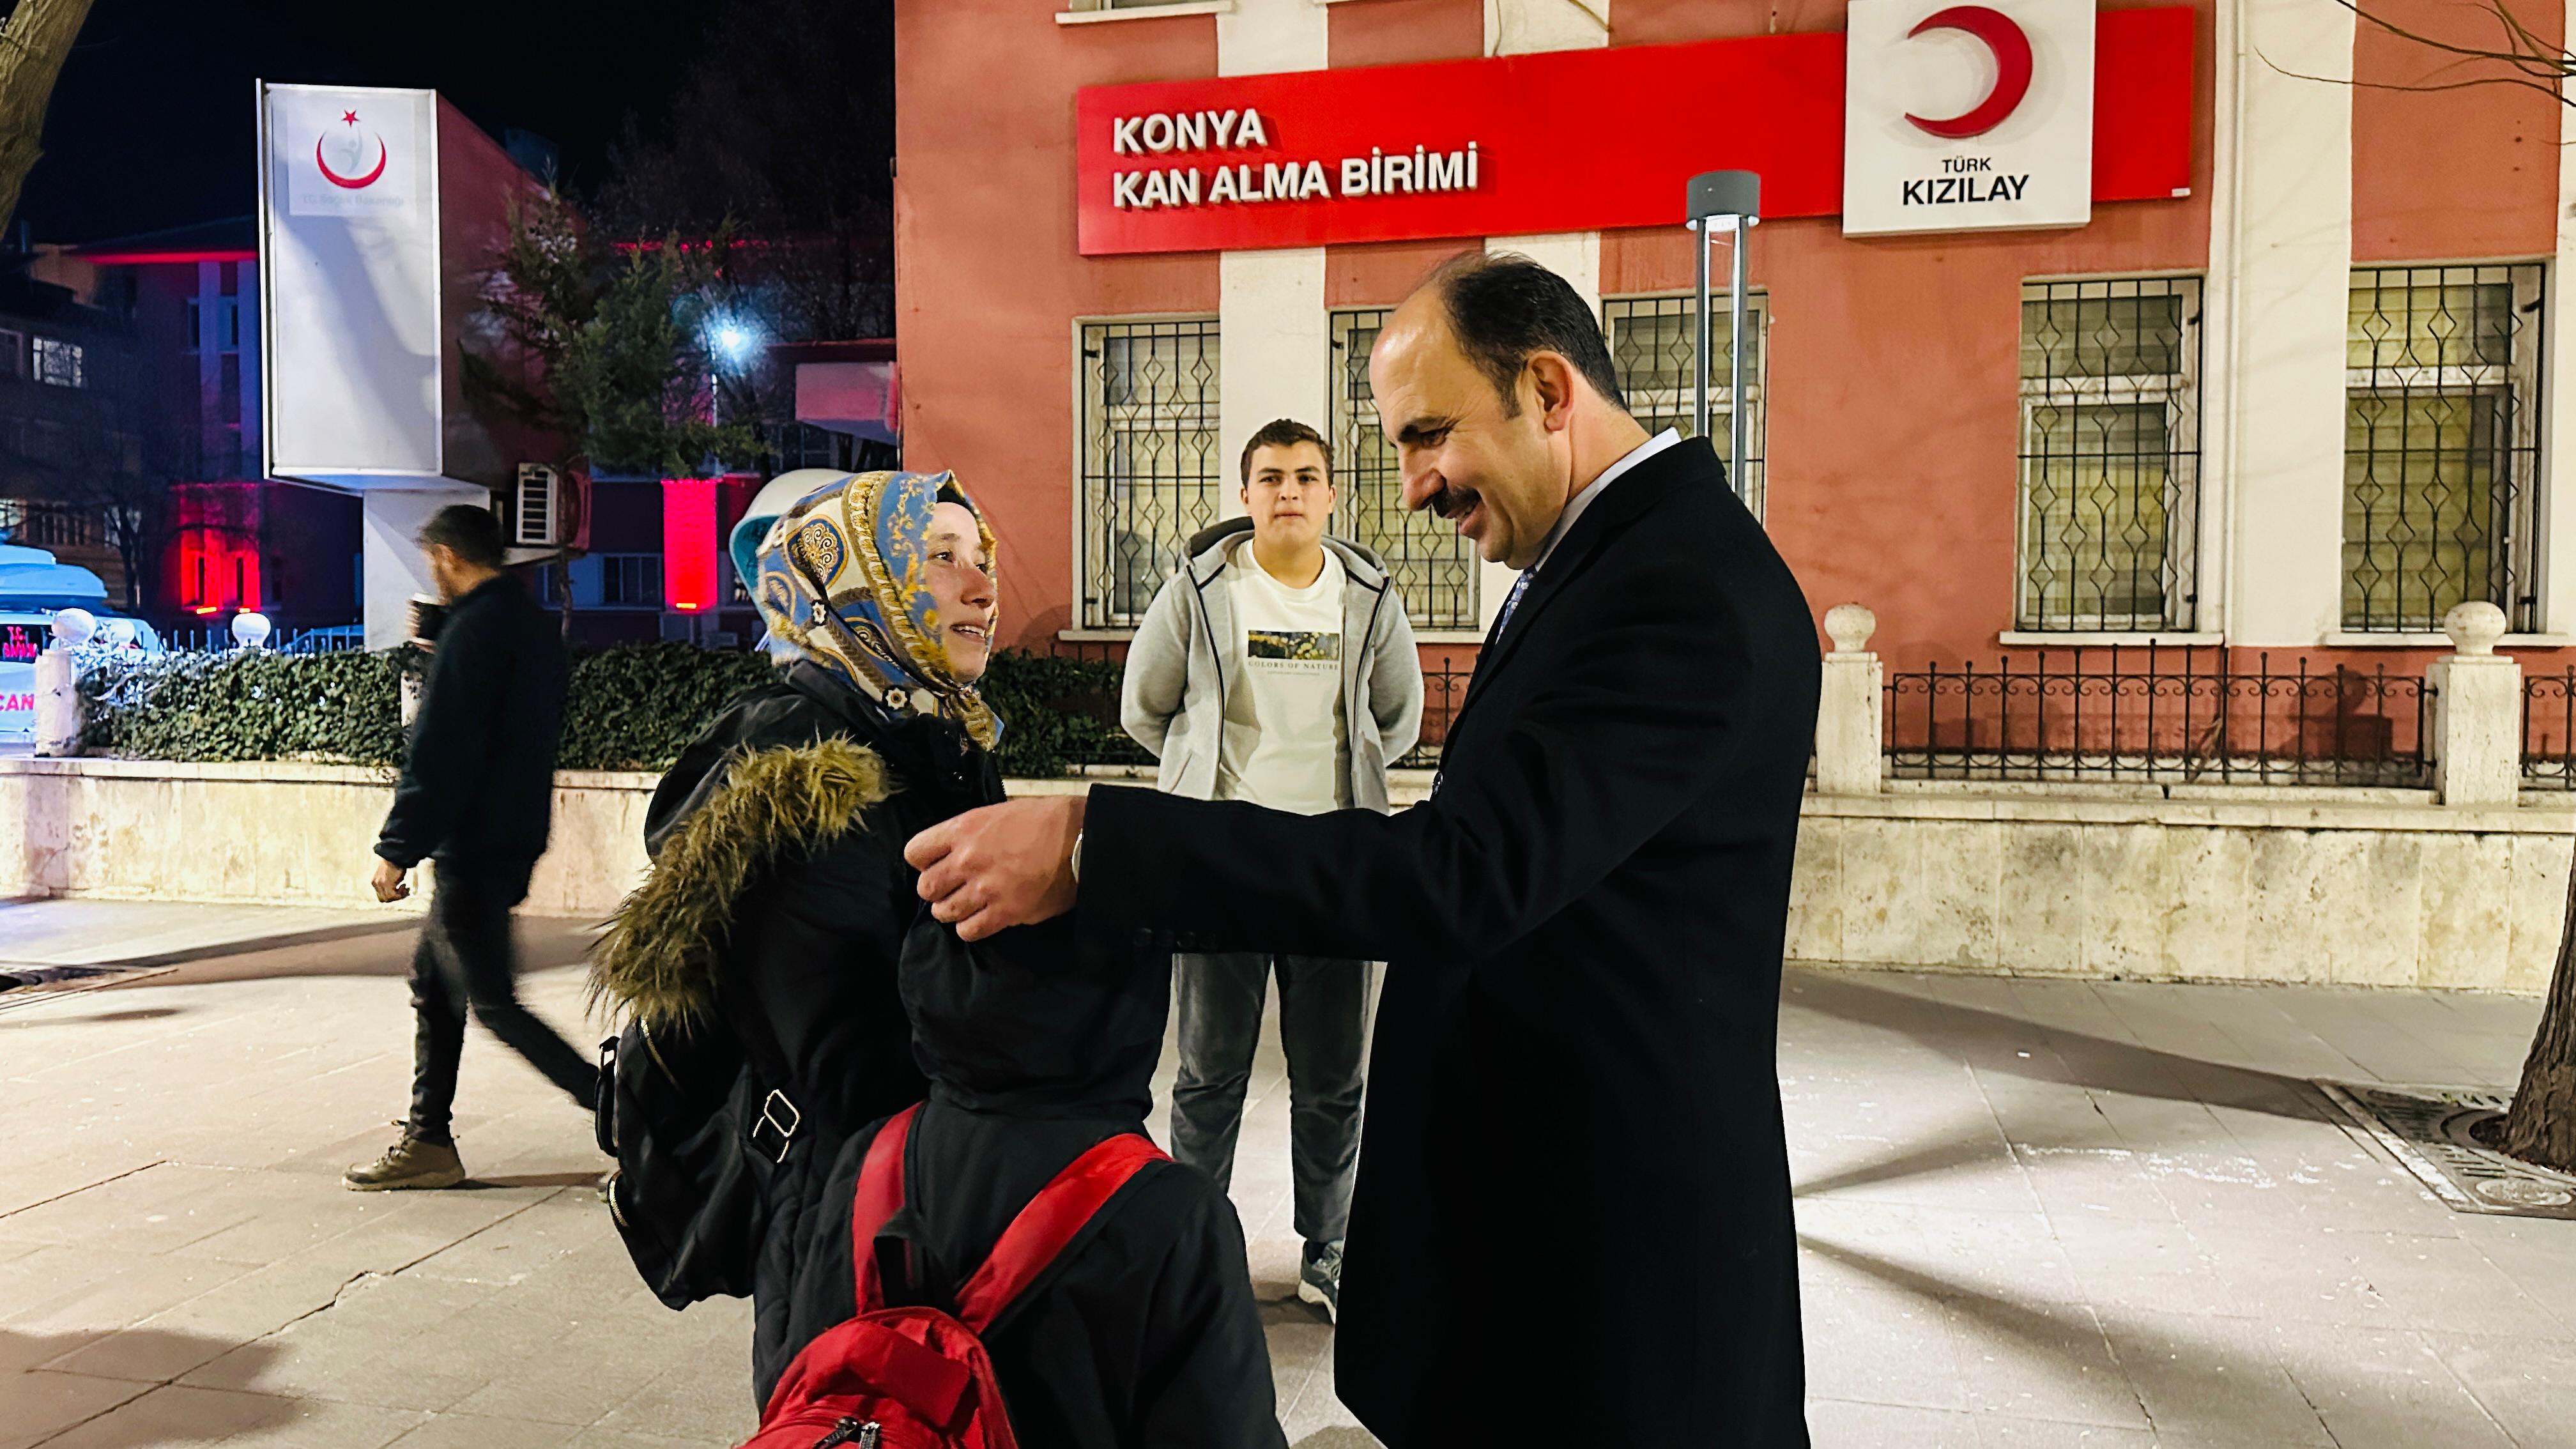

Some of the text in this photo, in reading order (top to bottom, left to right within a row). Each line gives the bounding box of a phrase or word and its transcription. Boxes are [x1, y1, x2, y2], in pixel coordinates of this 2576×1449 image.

[1113, 108, 1267, 155] KONYA
[1113, 141, 1478, 209] KAN ALMA BİRİMİ
[1942, 155, 1991, 173] TÜRK
[1903, 174, 2029, 206] KIZILAY
